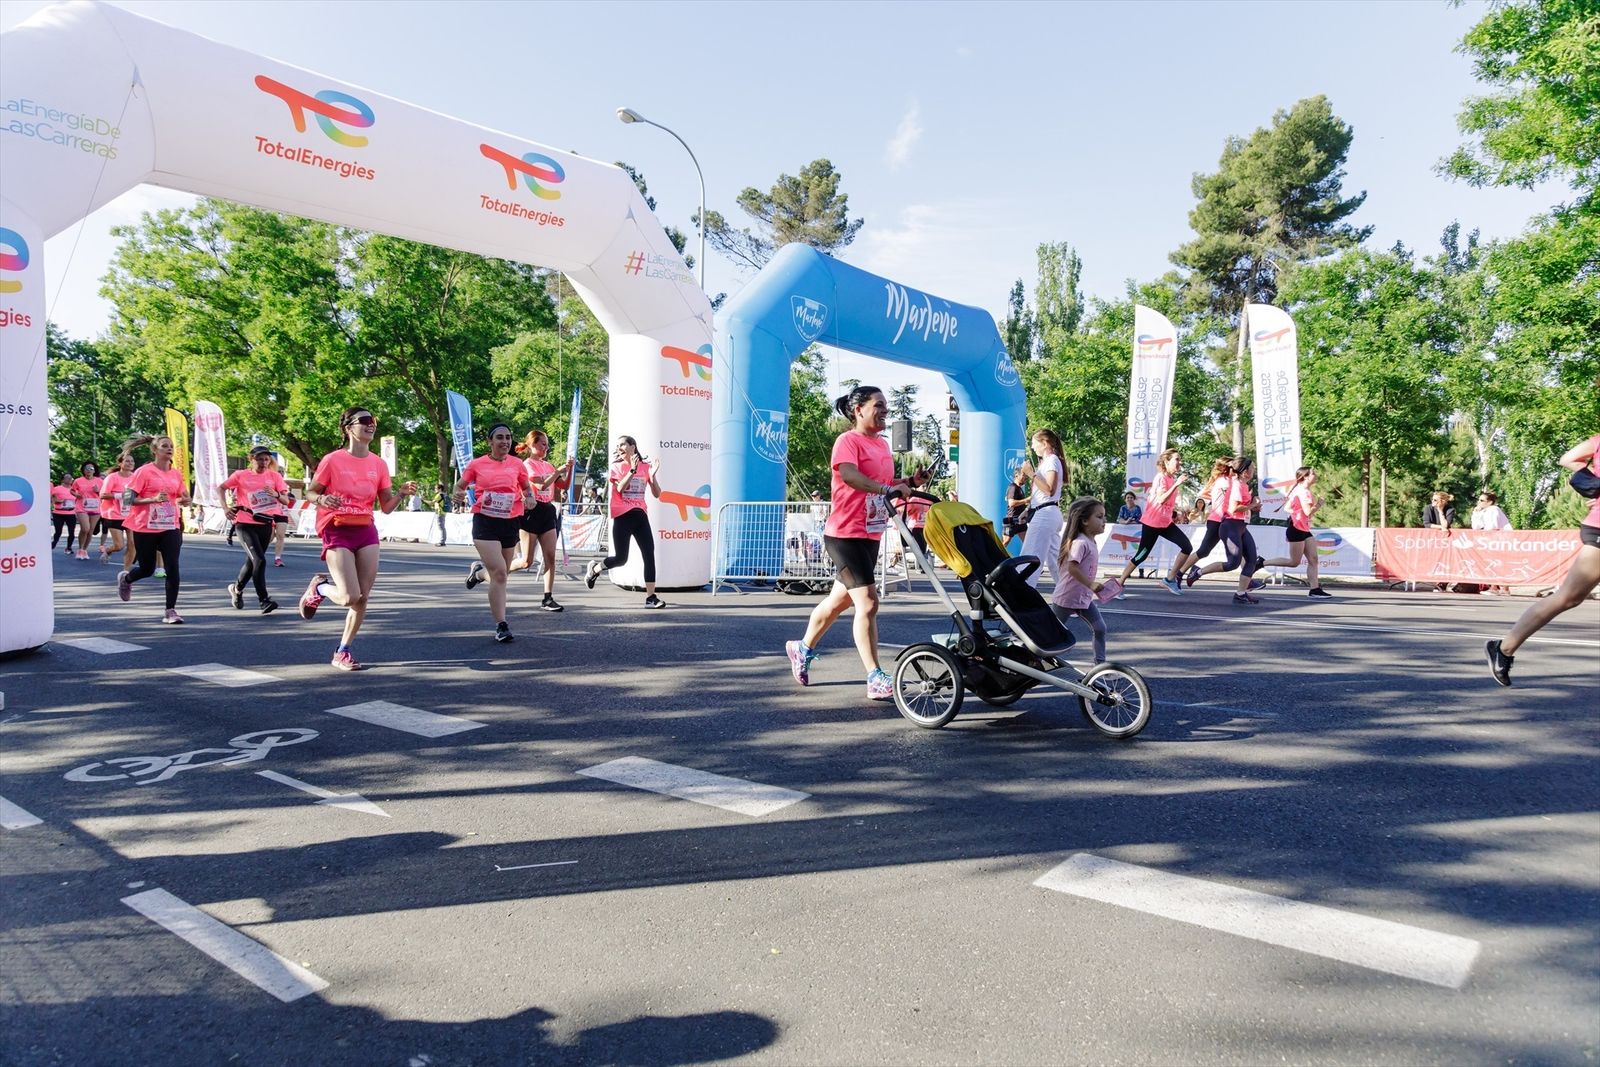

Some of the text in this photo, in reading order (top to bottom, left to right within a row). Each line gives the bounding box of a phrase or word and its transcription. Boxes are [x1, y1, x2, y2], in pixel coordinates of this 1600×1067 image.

[255, 136, 375, 181] TotalEnergies
[480, 195, 565, 227] TotalEnergies
[1394, 534, 1579, 553] Sports Santander
[1, 552, 36, 574] gies
